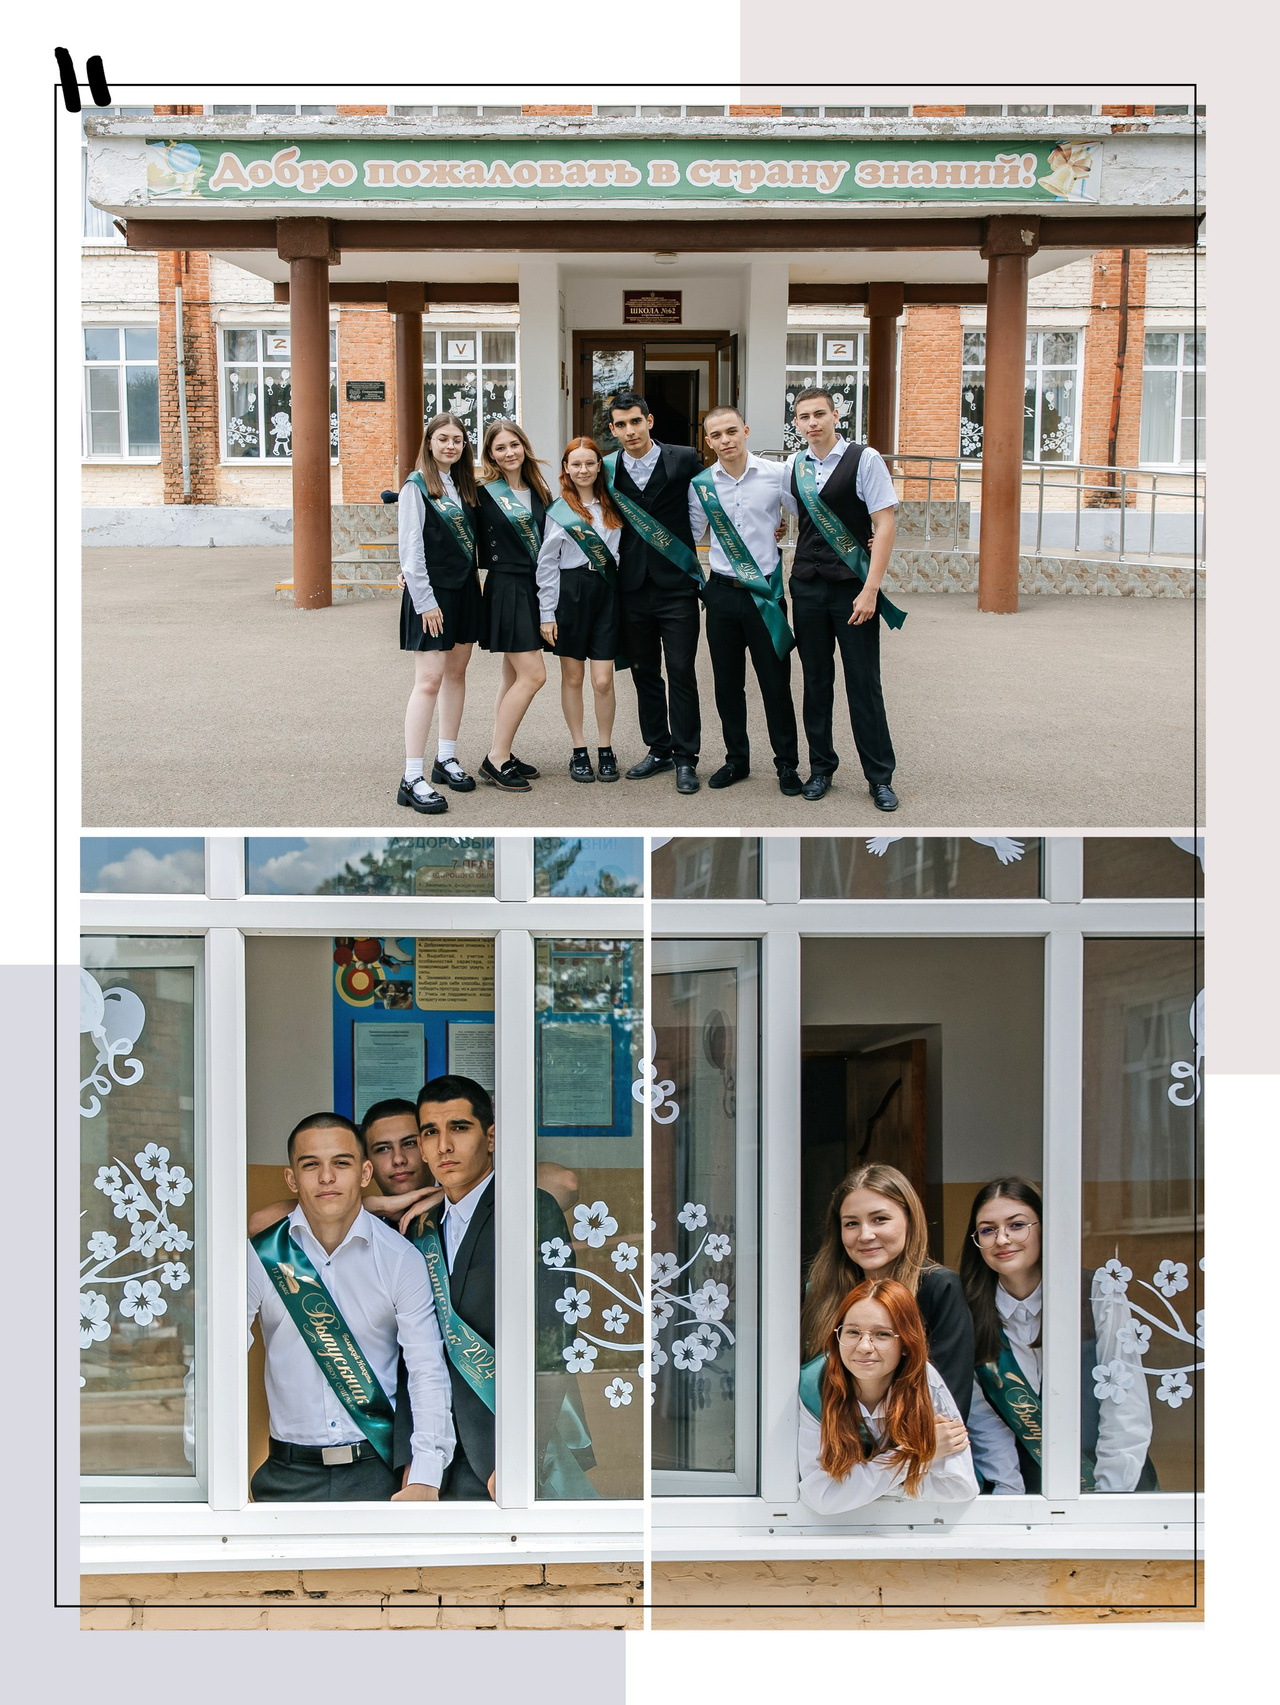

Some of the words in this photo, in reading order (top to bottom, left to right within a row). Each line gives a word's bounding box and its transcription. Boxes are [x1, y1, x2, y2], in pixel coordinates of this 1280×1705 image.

[209, 146, 355, 192] Добро
[364, 158, 641, 188] пожаловать
[648, 160, 680, 188] в
[686, 160, 850, 193] страну
[855, 153, 1037, 188] знаний!
[456, 343, 466, 354] V
[651, 526, 673, 547] 2024
[803, 478, 836, 534] Выпускник
[835, 532, 857, 554] 2024
[707, 499, 742, 558] Выпускник
[740, 559, 760, 582] 2024
[451, 859, 458, 869] 7
[301, 1294, 370, 1406] Выпускник
[462, 1340, 496, 1378] 2024
